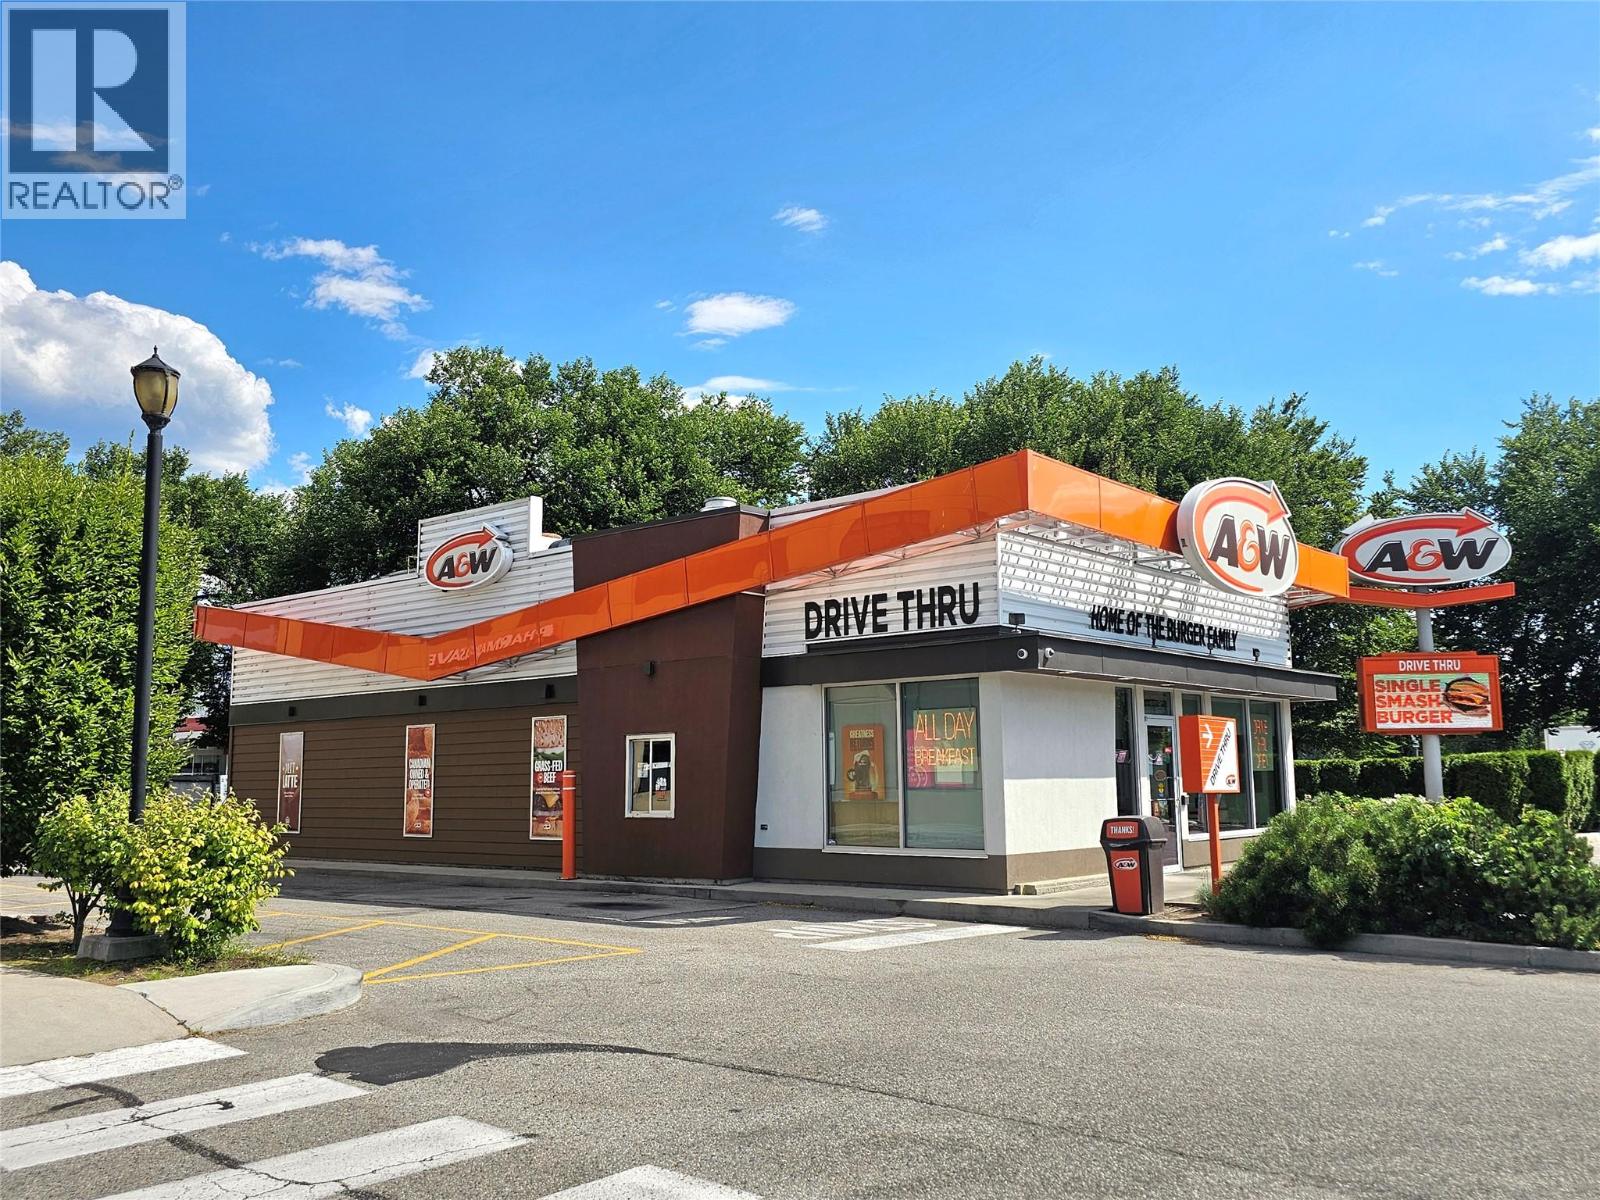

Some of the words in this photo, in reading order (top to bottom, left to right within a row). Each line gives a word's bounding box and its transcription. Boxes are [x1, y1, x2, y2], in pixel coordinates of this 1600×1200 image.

[1208, 514, 1291, 579] A&W
[1363, 537, 1499, 572] A&W
[436, 547, 498, 582] A&W
[804, 593, 888, 640] DRIVE
[896, 582, 980, 631] THRU
[1091, 604, 1125, 634] HOME
[1126, 611, 1144, 636] OF
[1145, 613, 1166, 641] THE
[1167, 618, 1206, 646] BURGER
[1207, 625, 1238, 651] FAMILY
[1398, 660, 1430, 671] DRIVE
[1432, 659, 1461, 671] THRU
[1375, 679, 1441, 693] SINGLE
[1375, 694, 1442, 708] SMASH
[1376, 710, 1453, 724] BURGER
[914, 713, 941, 741] ALL
[944, 711, 976, 741] DAY
[913, 747, 976, 767] BREAKFAST
[1210, 753, 1223, 786] DRIVE
[1219, 727, 1232, 756] THRU
[534, 760, 563, 772] GRASS-FED
[282, 774, 299, 789] LATTE
[409, 769, 424, 780] OWNED
[425, 769, 430, 779] &
[543, 772, 557, 783] BEEF
[1110, 825, 1135, 835] THANKS!
